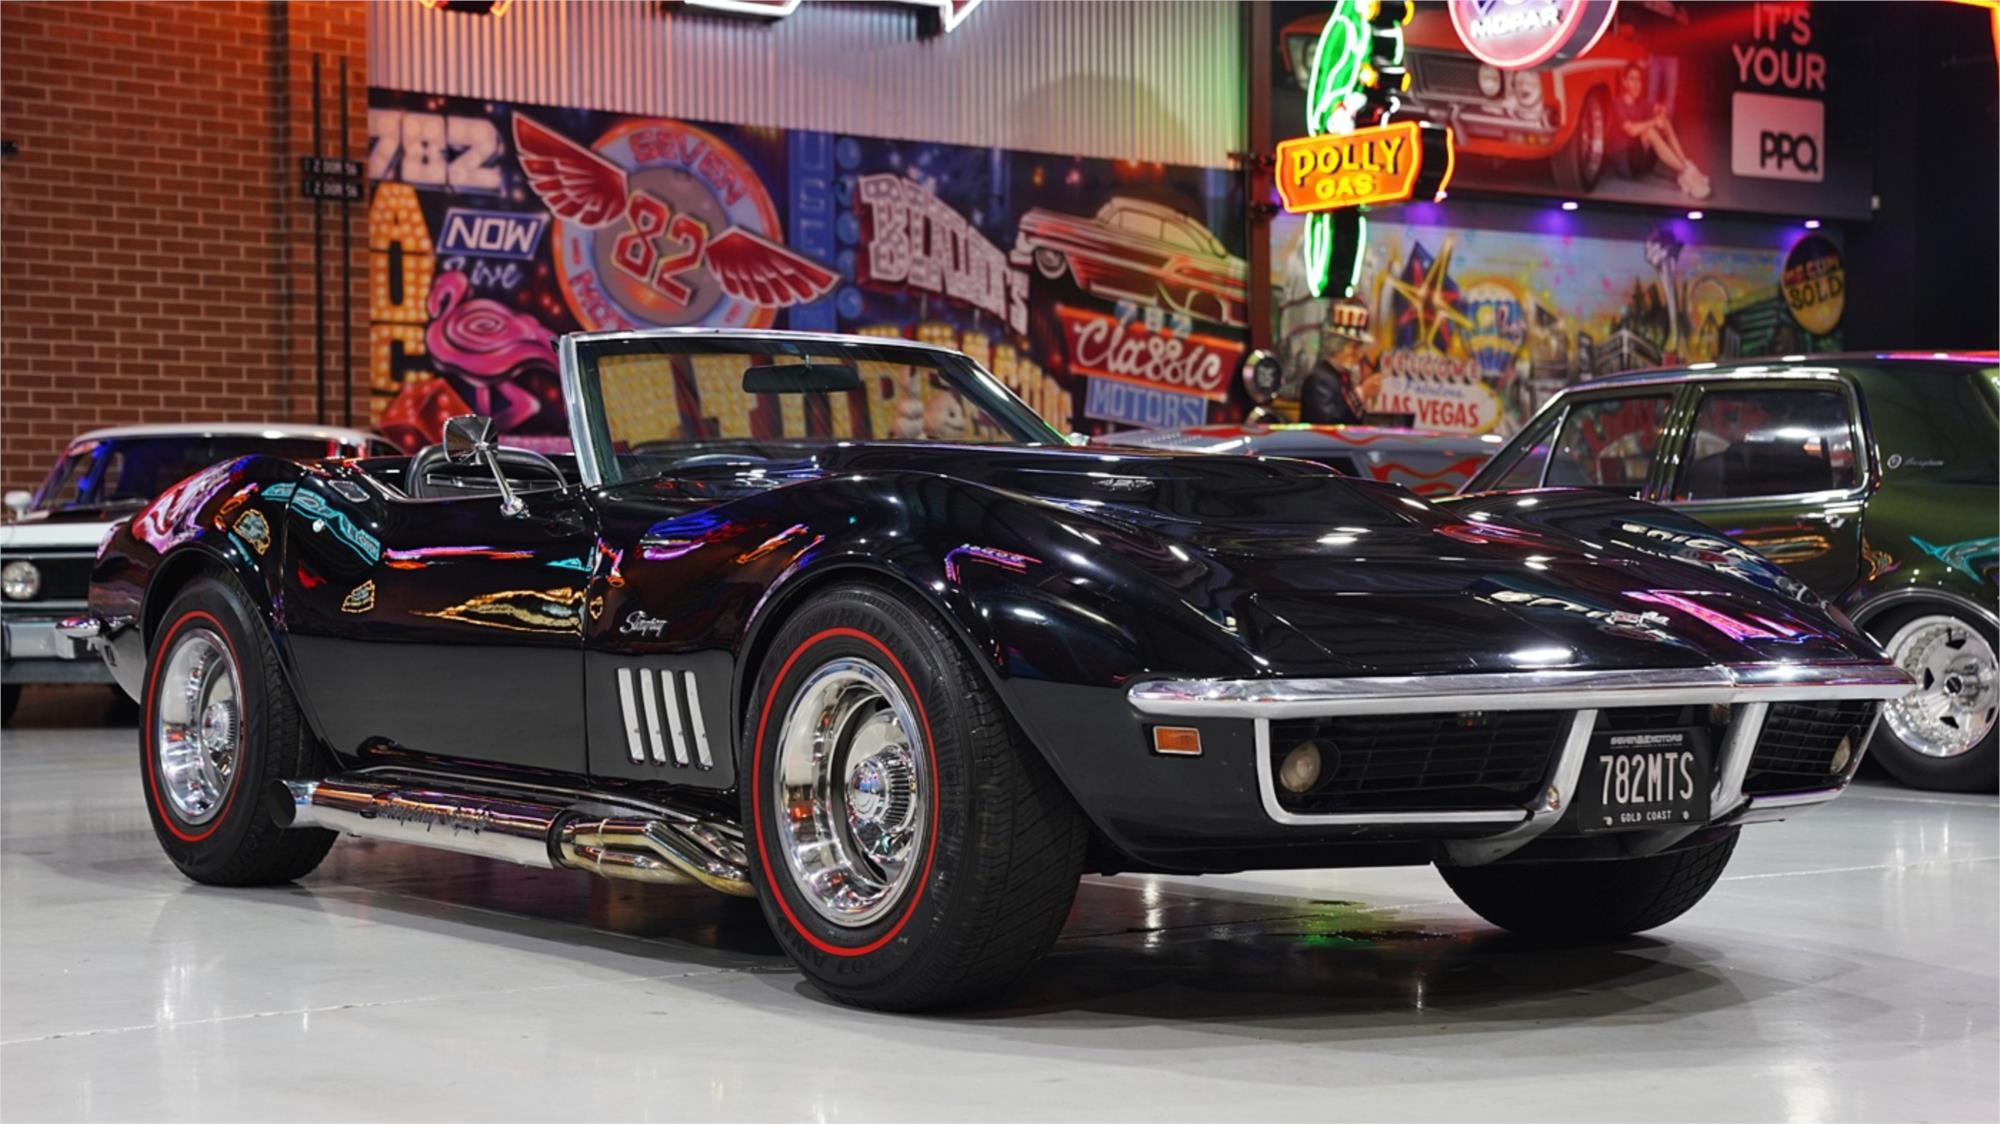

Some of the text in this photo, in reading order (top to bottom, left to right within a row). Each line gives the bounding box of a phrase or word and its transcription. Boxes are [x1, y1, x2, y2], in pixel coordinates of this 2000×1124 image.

[1470, 7, 1564, 39] MOPAR
[1753, 2, 1811, 45] IT'S
[1732, 44, 1827, 91] YOUR
[368, 109, 503, 189] 782
[629, 130, 746, 206] SEVEN
[1291, 136, 1403, 186] POLLY
[1760, 129, 1819, 174] PPQ
[1315, 173, 1374, 200] GAS
[446, 216, 538, 253] NOW
[611, 189, 709, 306] 82
[1789, 274, 1842, 310] SOLD
[1091, 378, 1202, 428] MOTORS
[1417, 398, 1479, 428] VEGAS
[1600, 751, 1694, 805] 782MTS
[1620, 810, 1672, 823] GOLD COAST
